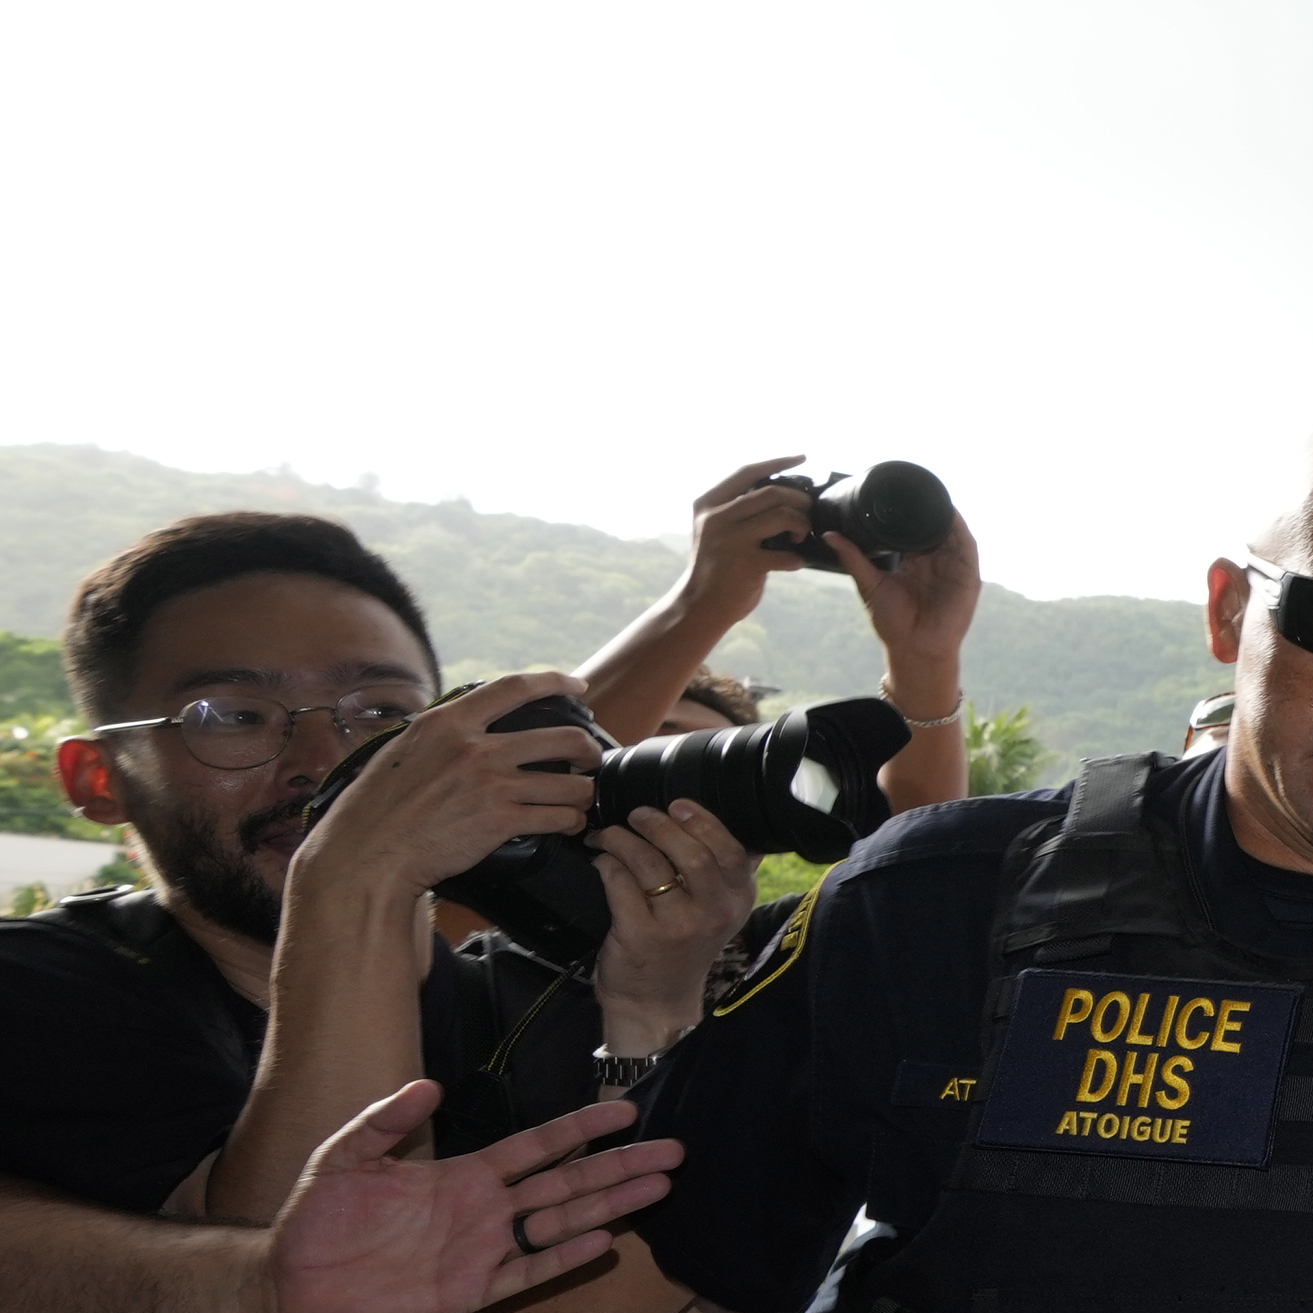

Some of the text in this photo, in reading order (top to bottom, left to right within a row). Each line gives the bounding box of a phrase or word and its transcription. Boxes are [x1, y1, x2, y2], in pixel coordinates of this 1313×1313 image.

[1052, 987, 1251, 1053] POLICE
[1076, 1048, 1194, 1110] DHS
[1055, 1110, 1191, 1144] ATOIGUE
